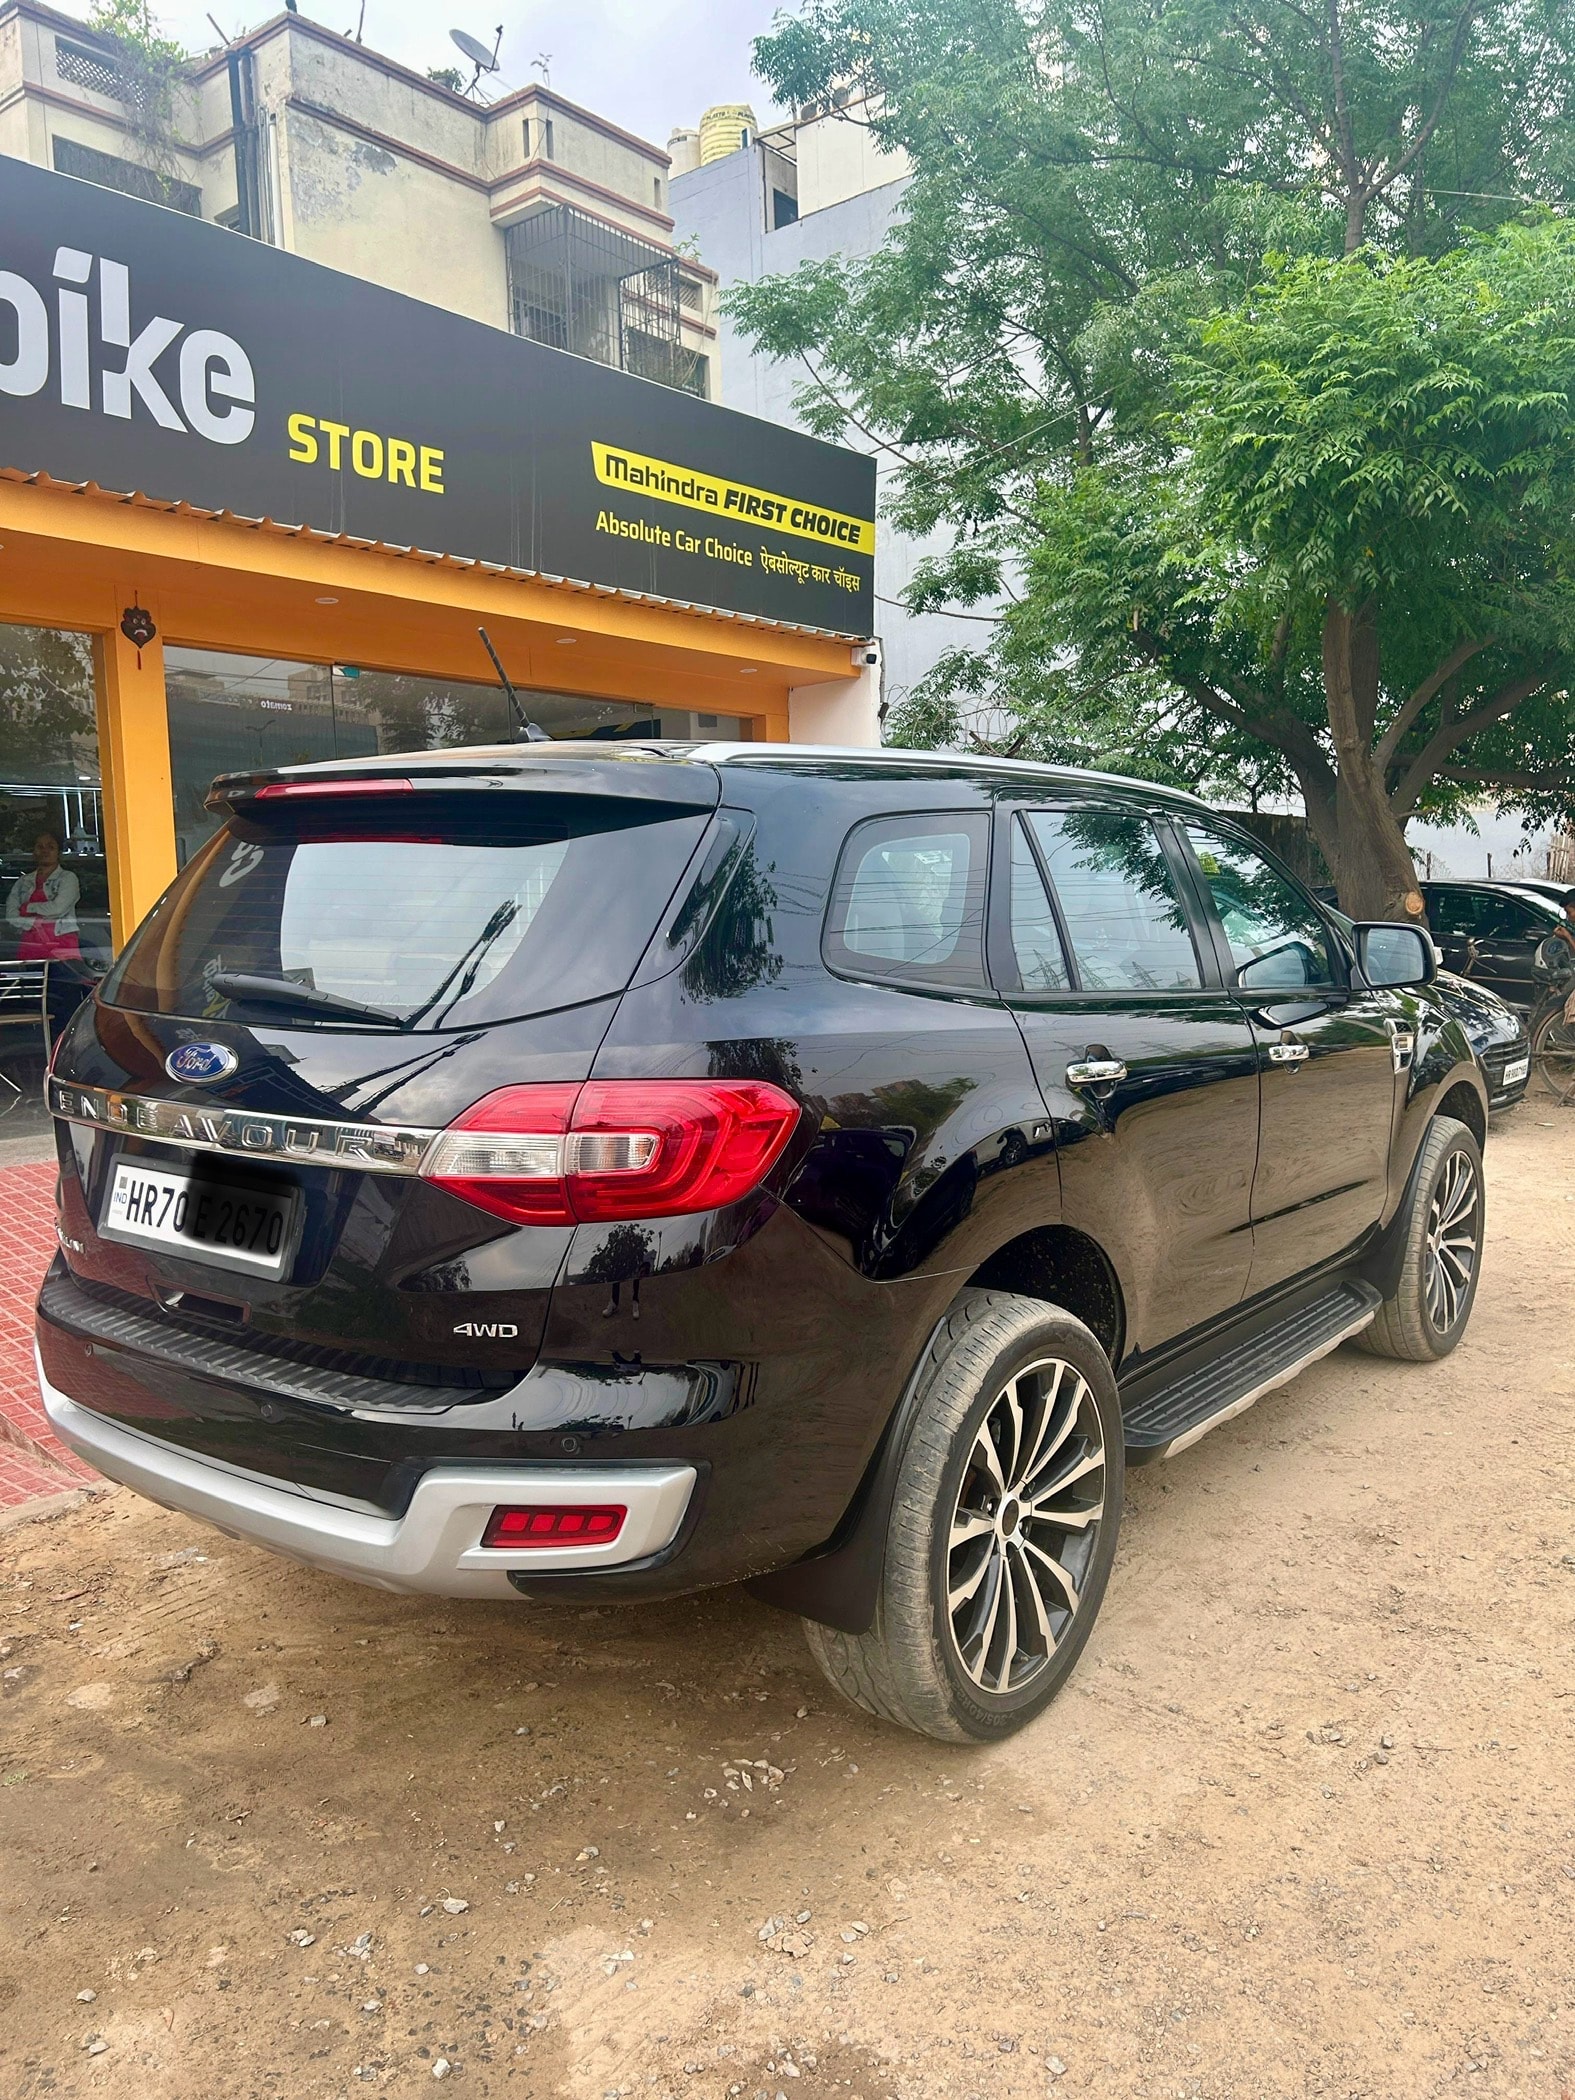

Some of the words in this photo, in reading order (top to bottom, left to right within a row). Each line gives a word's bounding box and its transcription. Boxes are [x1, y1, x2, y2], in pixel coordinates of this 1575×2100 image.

[288, 413, 445, 494] STORE
[606, 454, 718, 506] Mahindra
[723, 488, 787, 524] FIRST
[790, 508, 861, 545] CHOICE
[595, 510, 671, 547] Absolute
[675, 530, 700, 554] Car
[704, 537, 752, 567] Choice
[760, 546, 809, 584] ऐबसोल्यूट
[811, 564, 831, 584] कार
[833, 566, 861, 592] चॉइस
[176, 1046, 217, 1072] Ford
[59, 1089, 376, 1162] ENDEAVOUR
[113, 1191, 127, 1204] IND
[126, 1180, 189, 1232] HR70
[214, 1200, 283, 1254] 2670
[453, 1322, 518, 1338] 4WD
